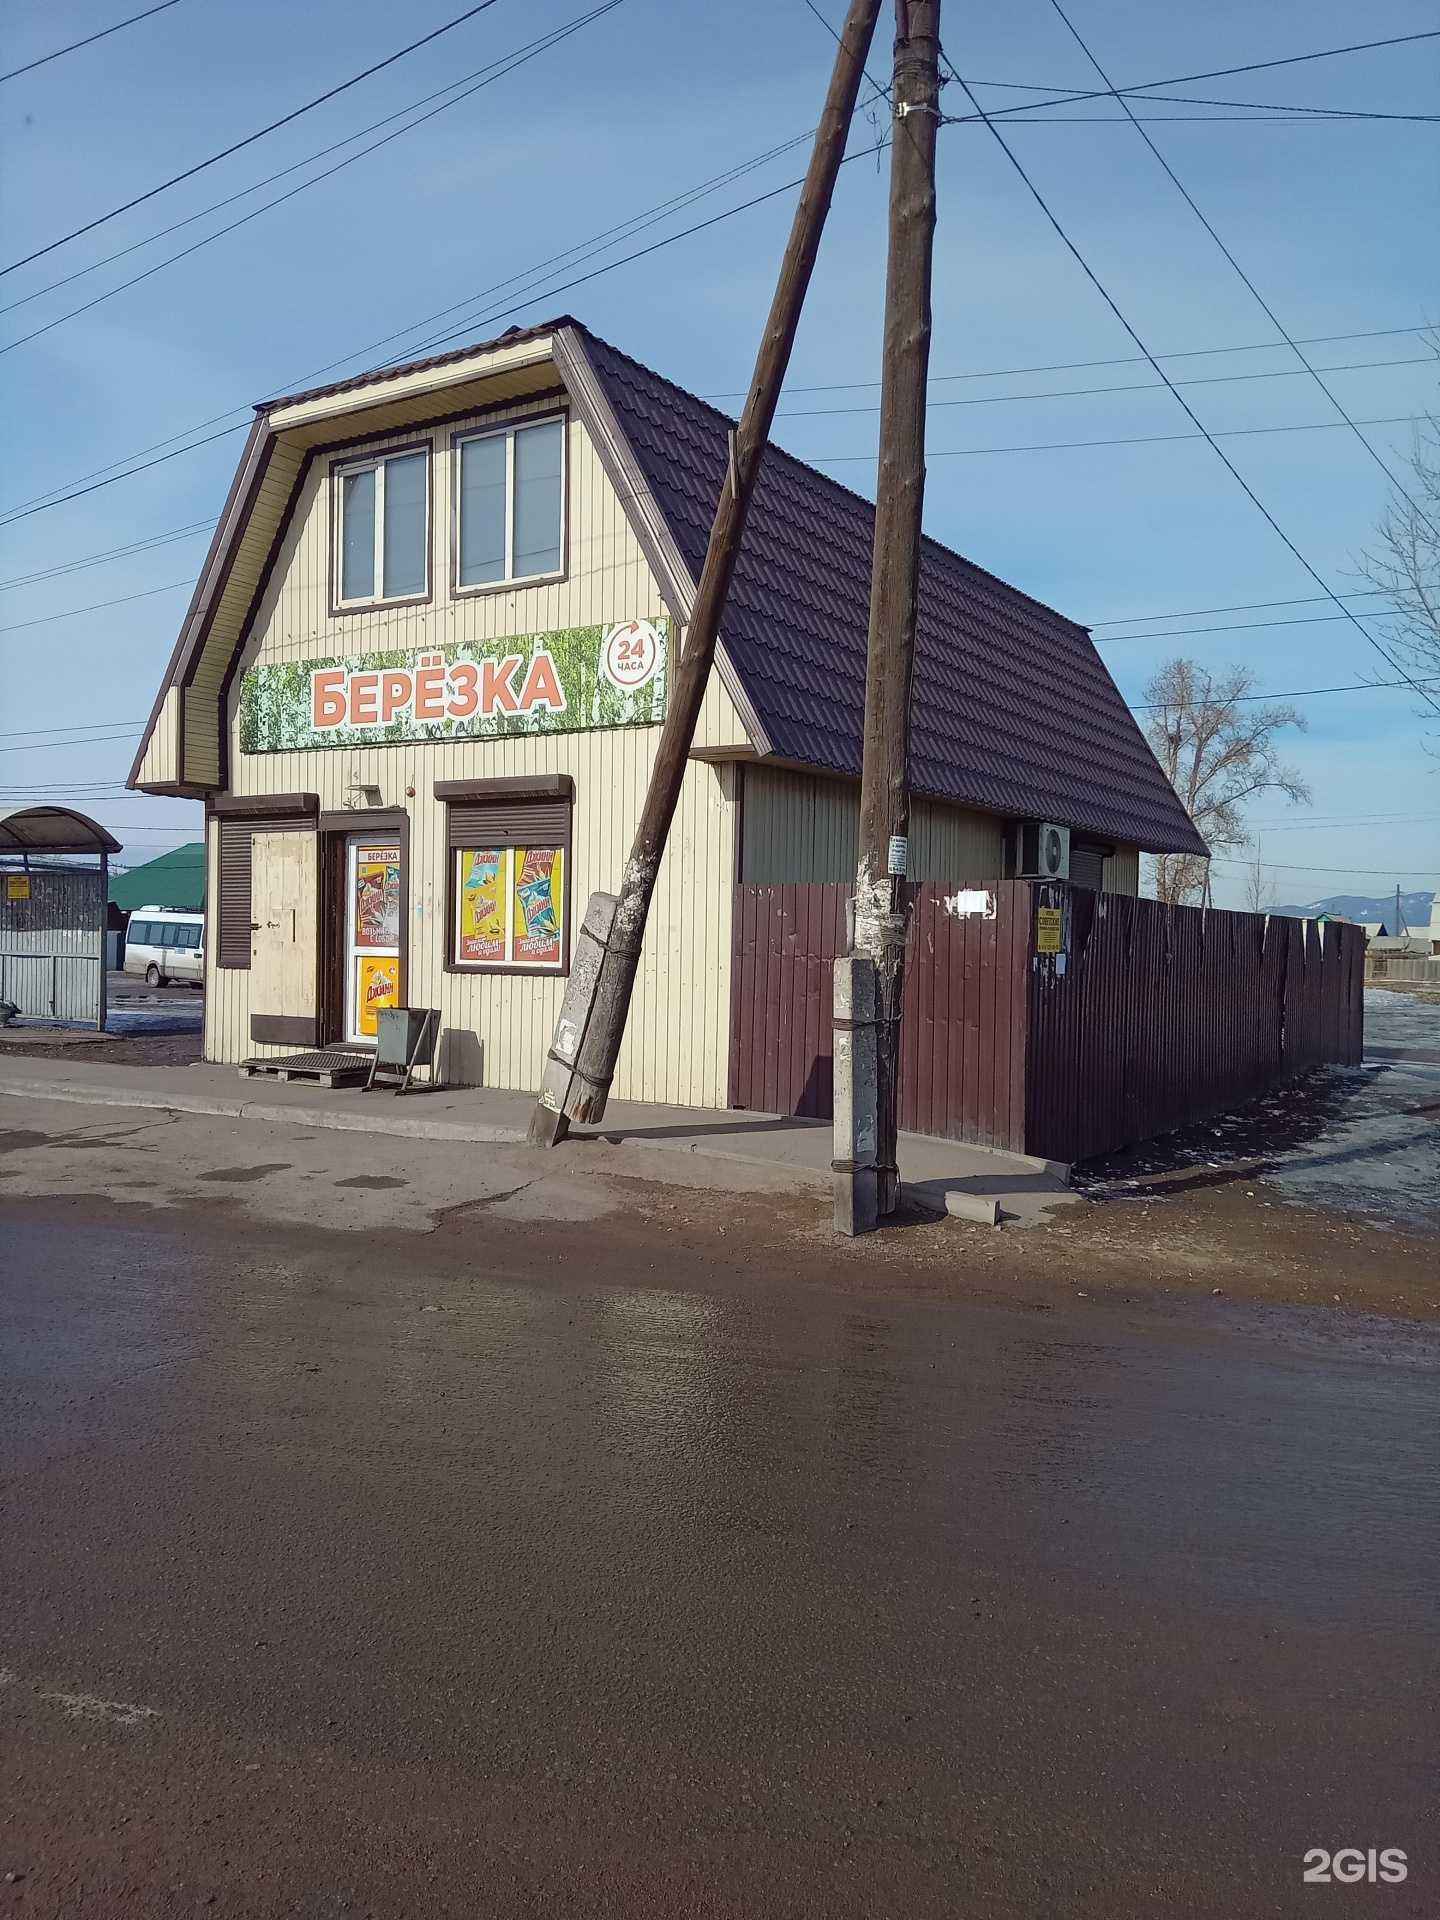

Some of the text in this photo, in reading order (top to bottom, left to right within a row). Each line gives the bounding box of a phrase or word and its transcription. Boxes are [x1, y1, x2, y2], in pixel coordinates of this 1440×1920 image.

[617, 638, 645, 660] 24
[617, 660, 645, 671] ЧАСА
[313, 655, 564, 728] БЕРЁЗКА
